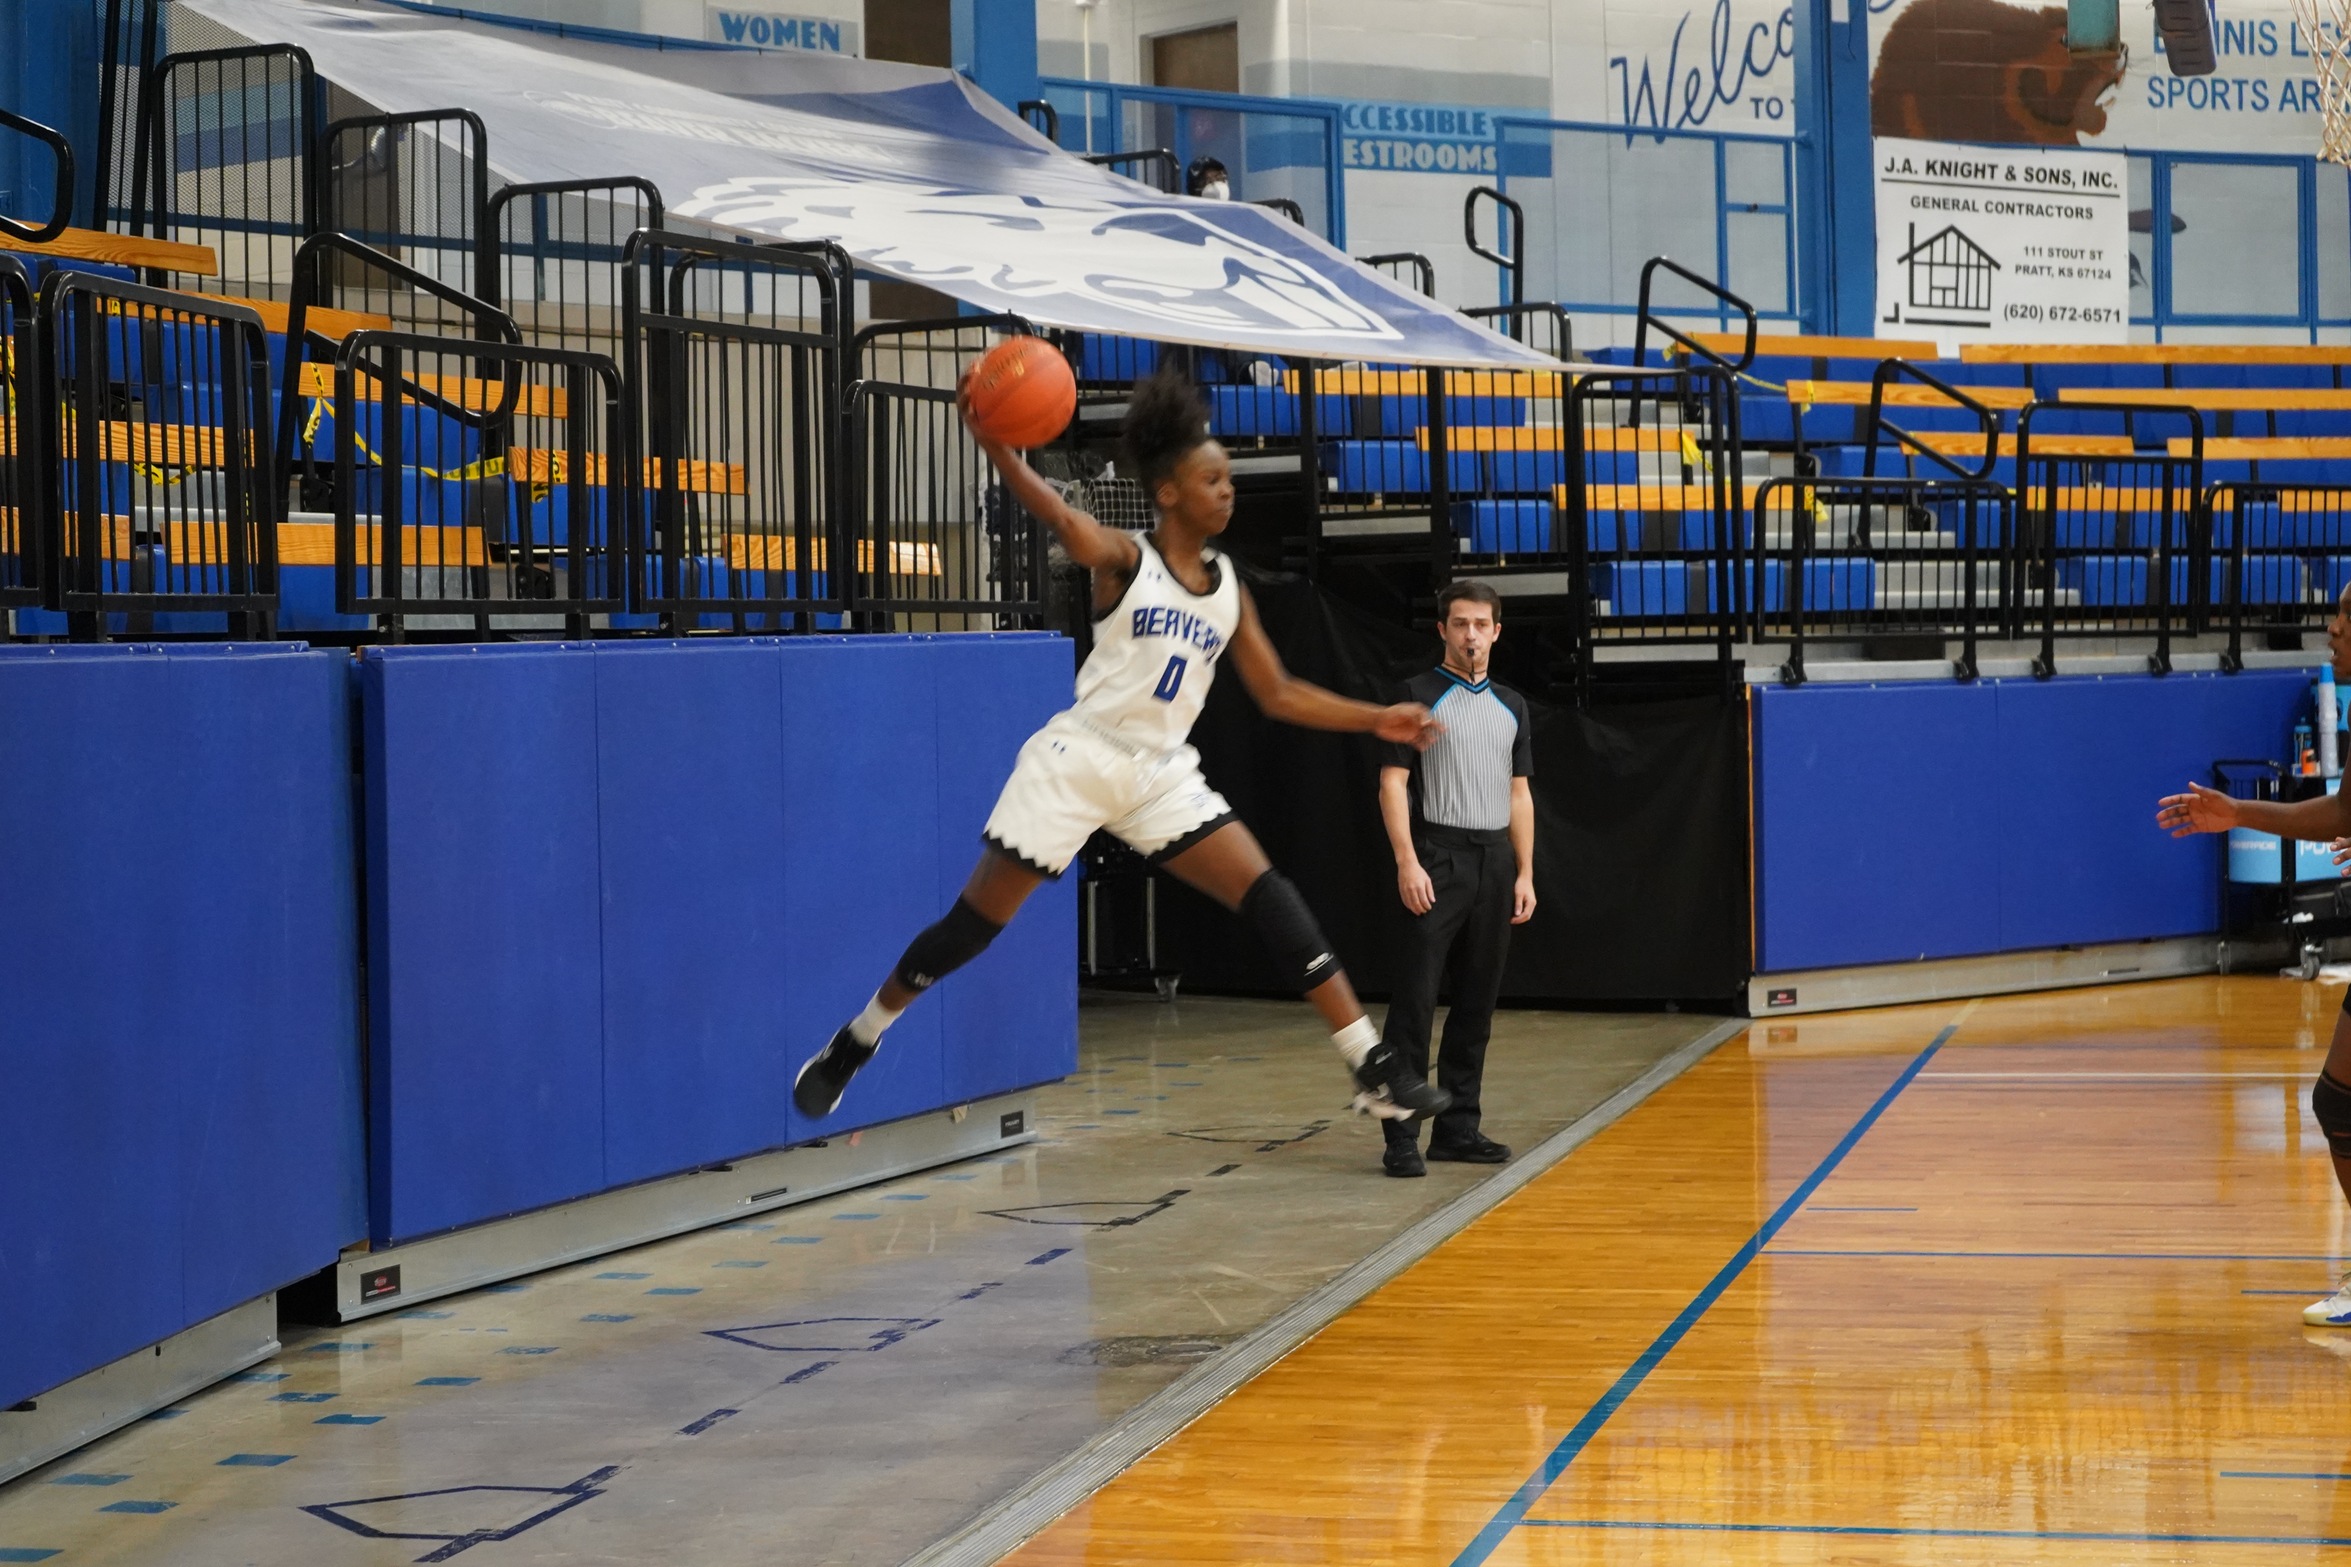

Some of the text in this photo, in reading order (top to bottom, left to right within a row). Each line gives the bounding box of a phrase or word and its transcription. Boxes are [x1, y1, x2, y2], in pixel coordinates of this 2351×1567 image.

[718, 12, 840, 51] WOMEN
[1610, 0, 1794, 150] Welco
[1750, 98, 1784, 119] TO
[2147, 76, 2270, 112] SPORTS
[1343, 104, 1487, 136] CCESSIBLE
[1343, 138, 1498, 172] ESTROOMS
[1884, 157, 2119, 189] J.A. KNIGHT & SONS, INC.
[1910, 195, 2094, 220] GENERAL CONTRACTORS
[2023, 246, 2104, 261] 111 STOUT ST
[2015, 264, 2112, 280] PRATT, KS 67124
[2003, 303, 2121, 323] (620) 672-6571
[1132, 606, 1222, 661] BEAVER
[1152, 654, 1188, 702] 0
